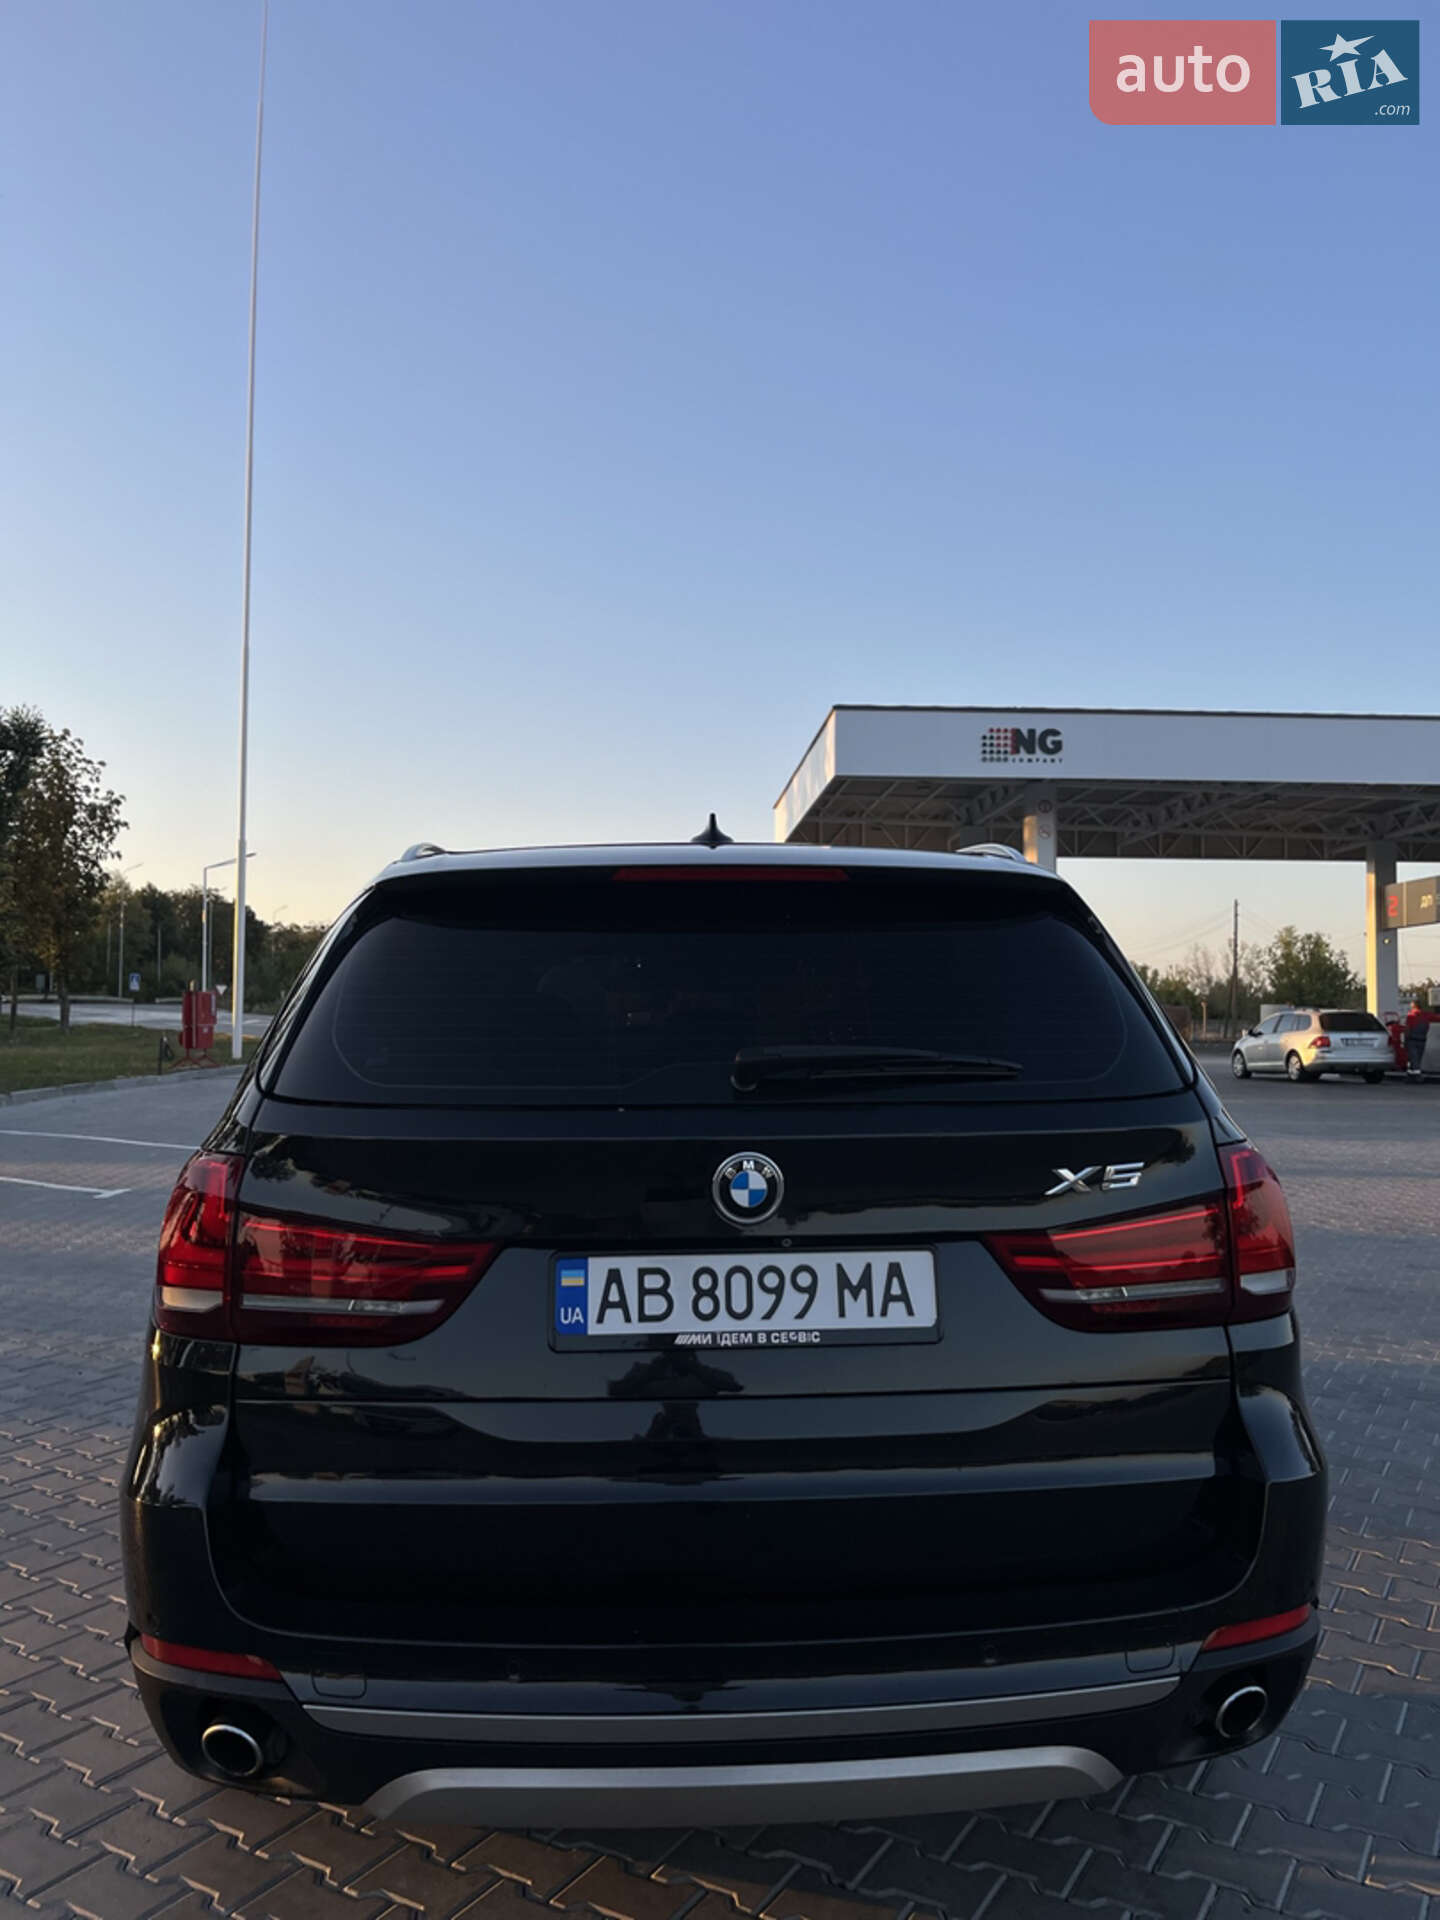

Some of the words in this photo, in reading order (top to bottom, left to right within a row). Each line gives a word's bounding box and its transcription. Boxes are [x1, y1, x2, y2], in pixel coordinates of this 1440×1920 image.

[1387, 894, 1399, 918] 2
[1044, 1162, 1144, 1195] X5
[596, 1267, 675, 1324] AB
[691, 1264, 819, 1321] 8099
[836, 1261, 915, 1318] MA
[560, 1306, 585, 1325] UA
